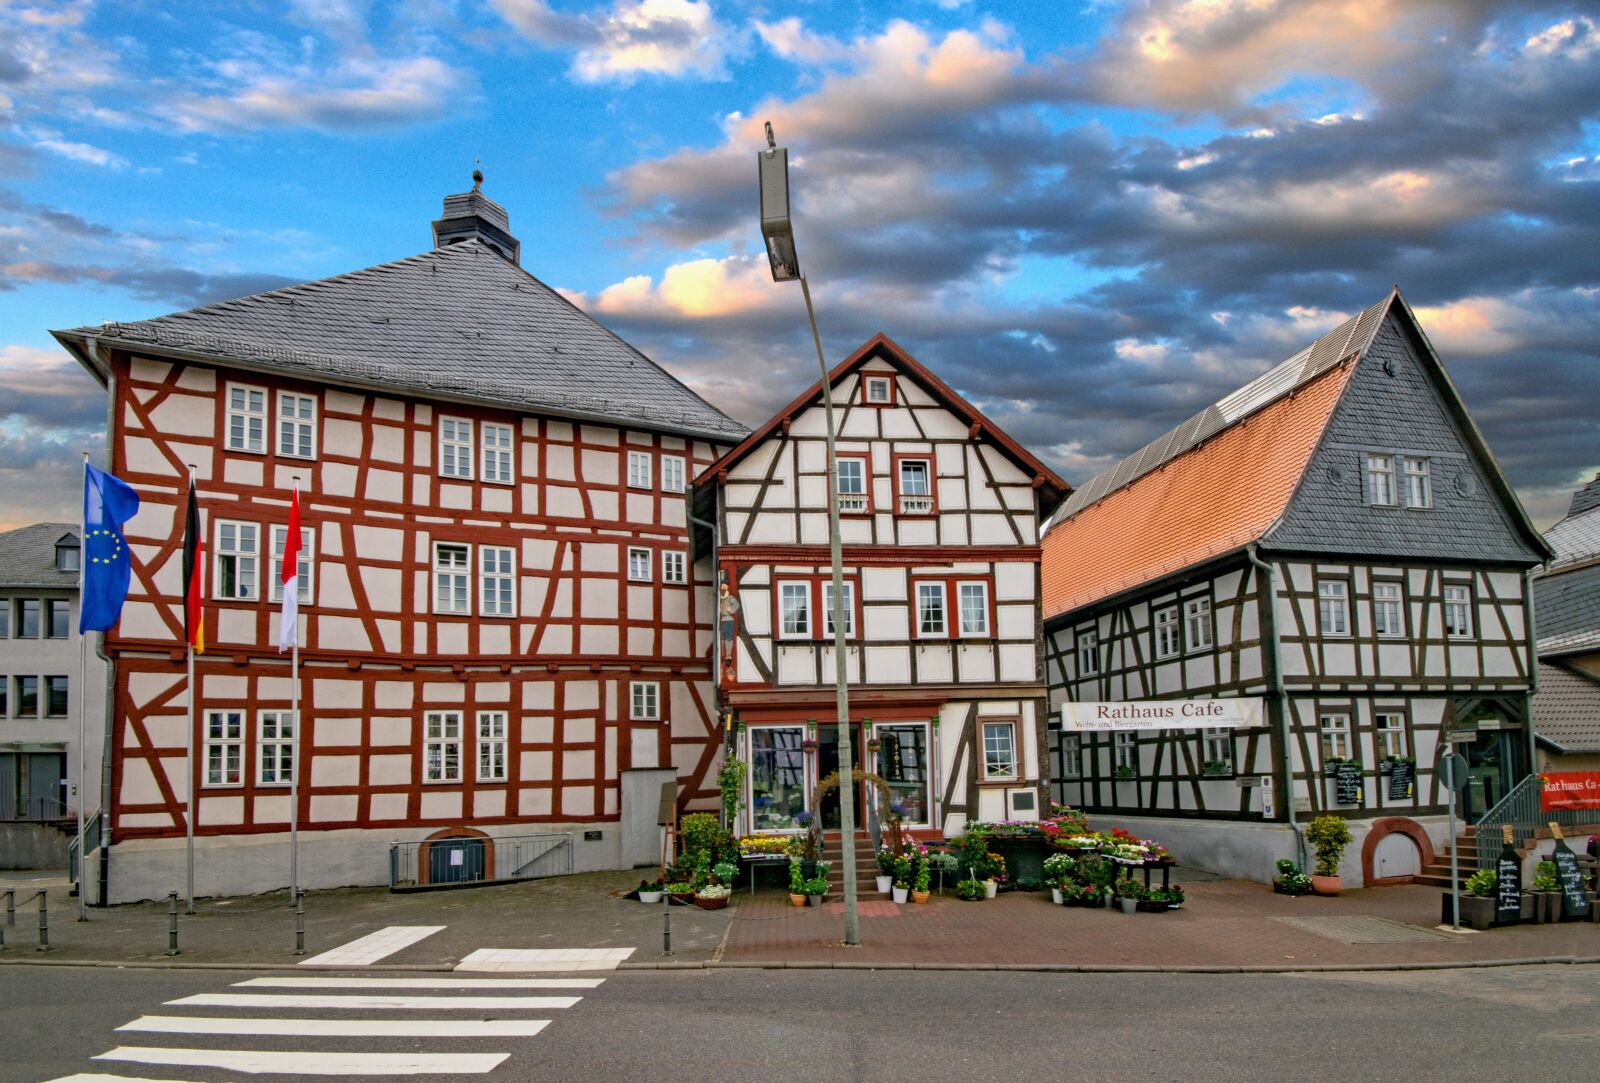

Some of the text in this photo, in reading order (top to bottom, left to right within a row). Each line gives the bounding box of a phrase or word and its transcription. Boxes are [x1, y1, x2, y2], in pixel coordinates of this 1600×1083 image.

[1097, 701, 1224, 719] Rathaus Cafe
[1098, 720, 1113, 728] und
[1115, 720, 1153, 729] Biergarten
[1544, 779, 1584, 792] Rathaus
